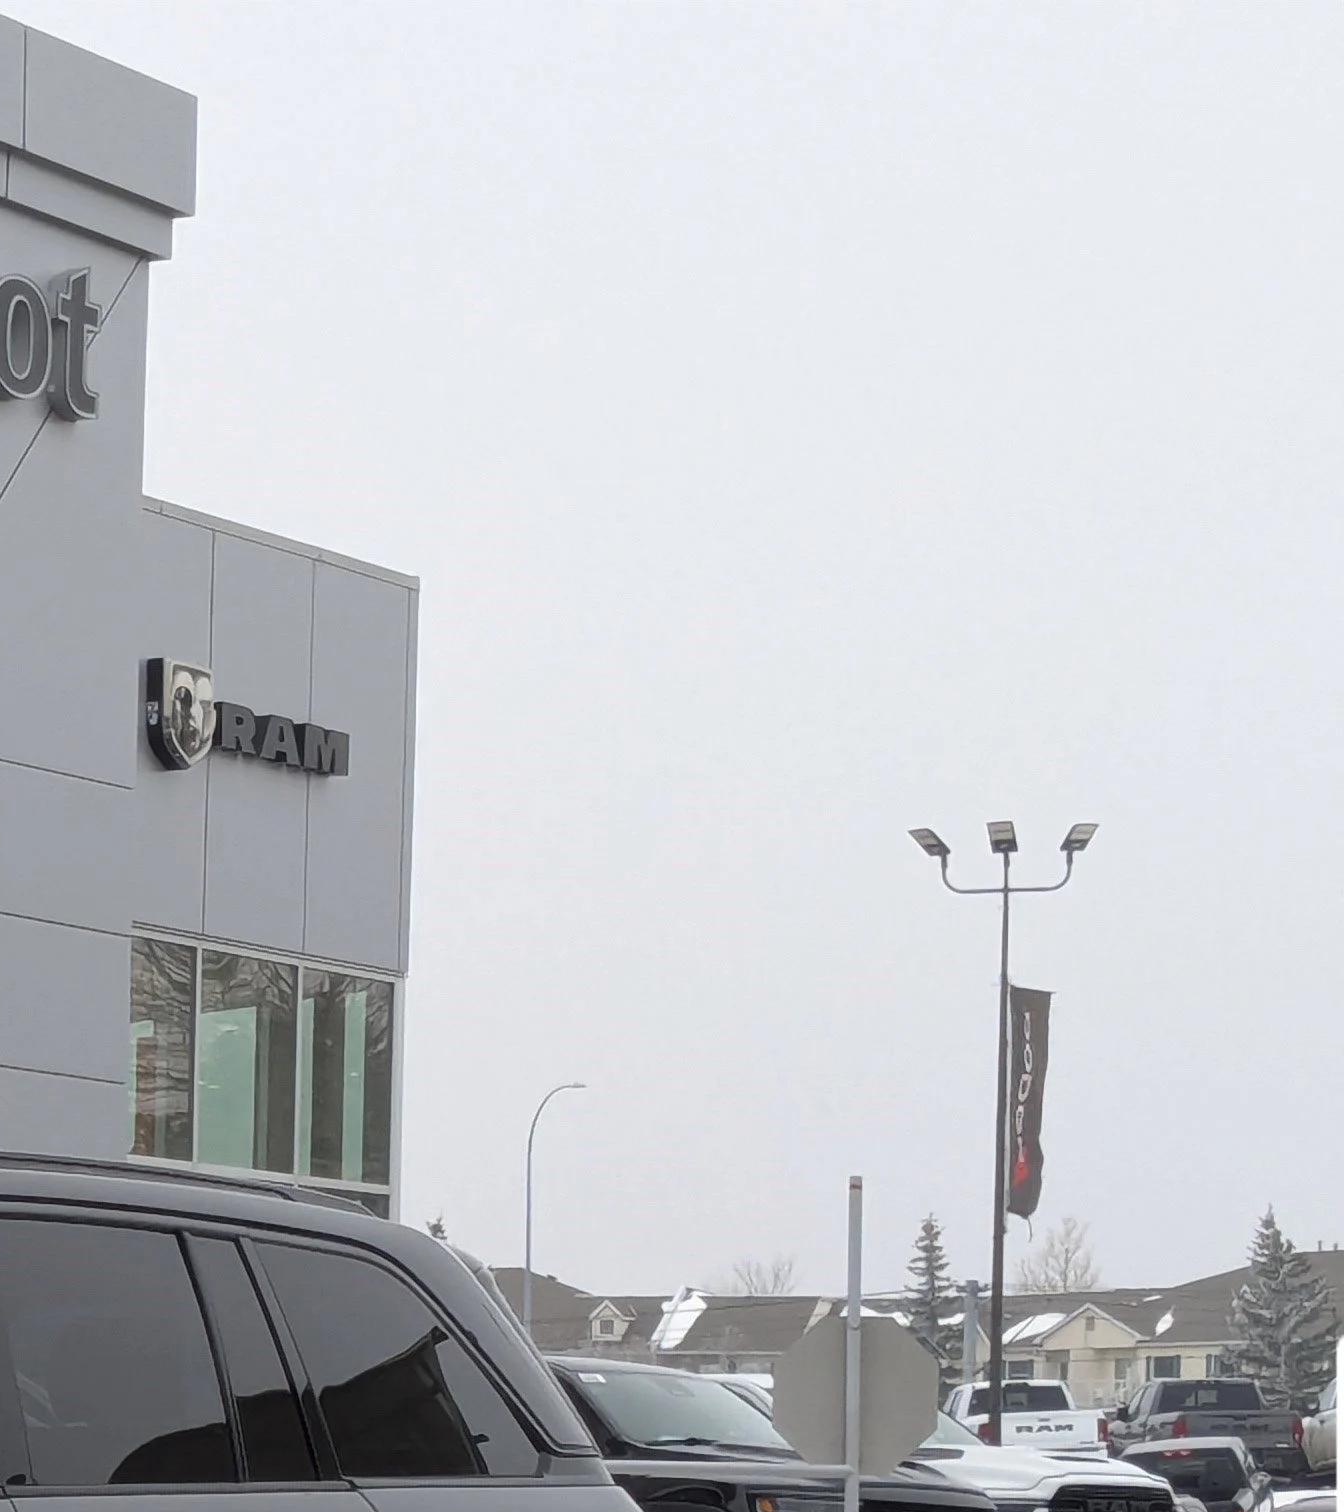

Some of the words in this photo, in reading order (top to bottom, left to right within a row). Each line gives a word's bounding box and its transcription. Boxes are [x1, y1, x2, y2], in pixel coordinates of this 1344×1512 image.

[216, 701, 350, 776] RAM
[1015, 1012, 1033, 1163] DODG
[1015, 1424, 1074, 1434] RAM
